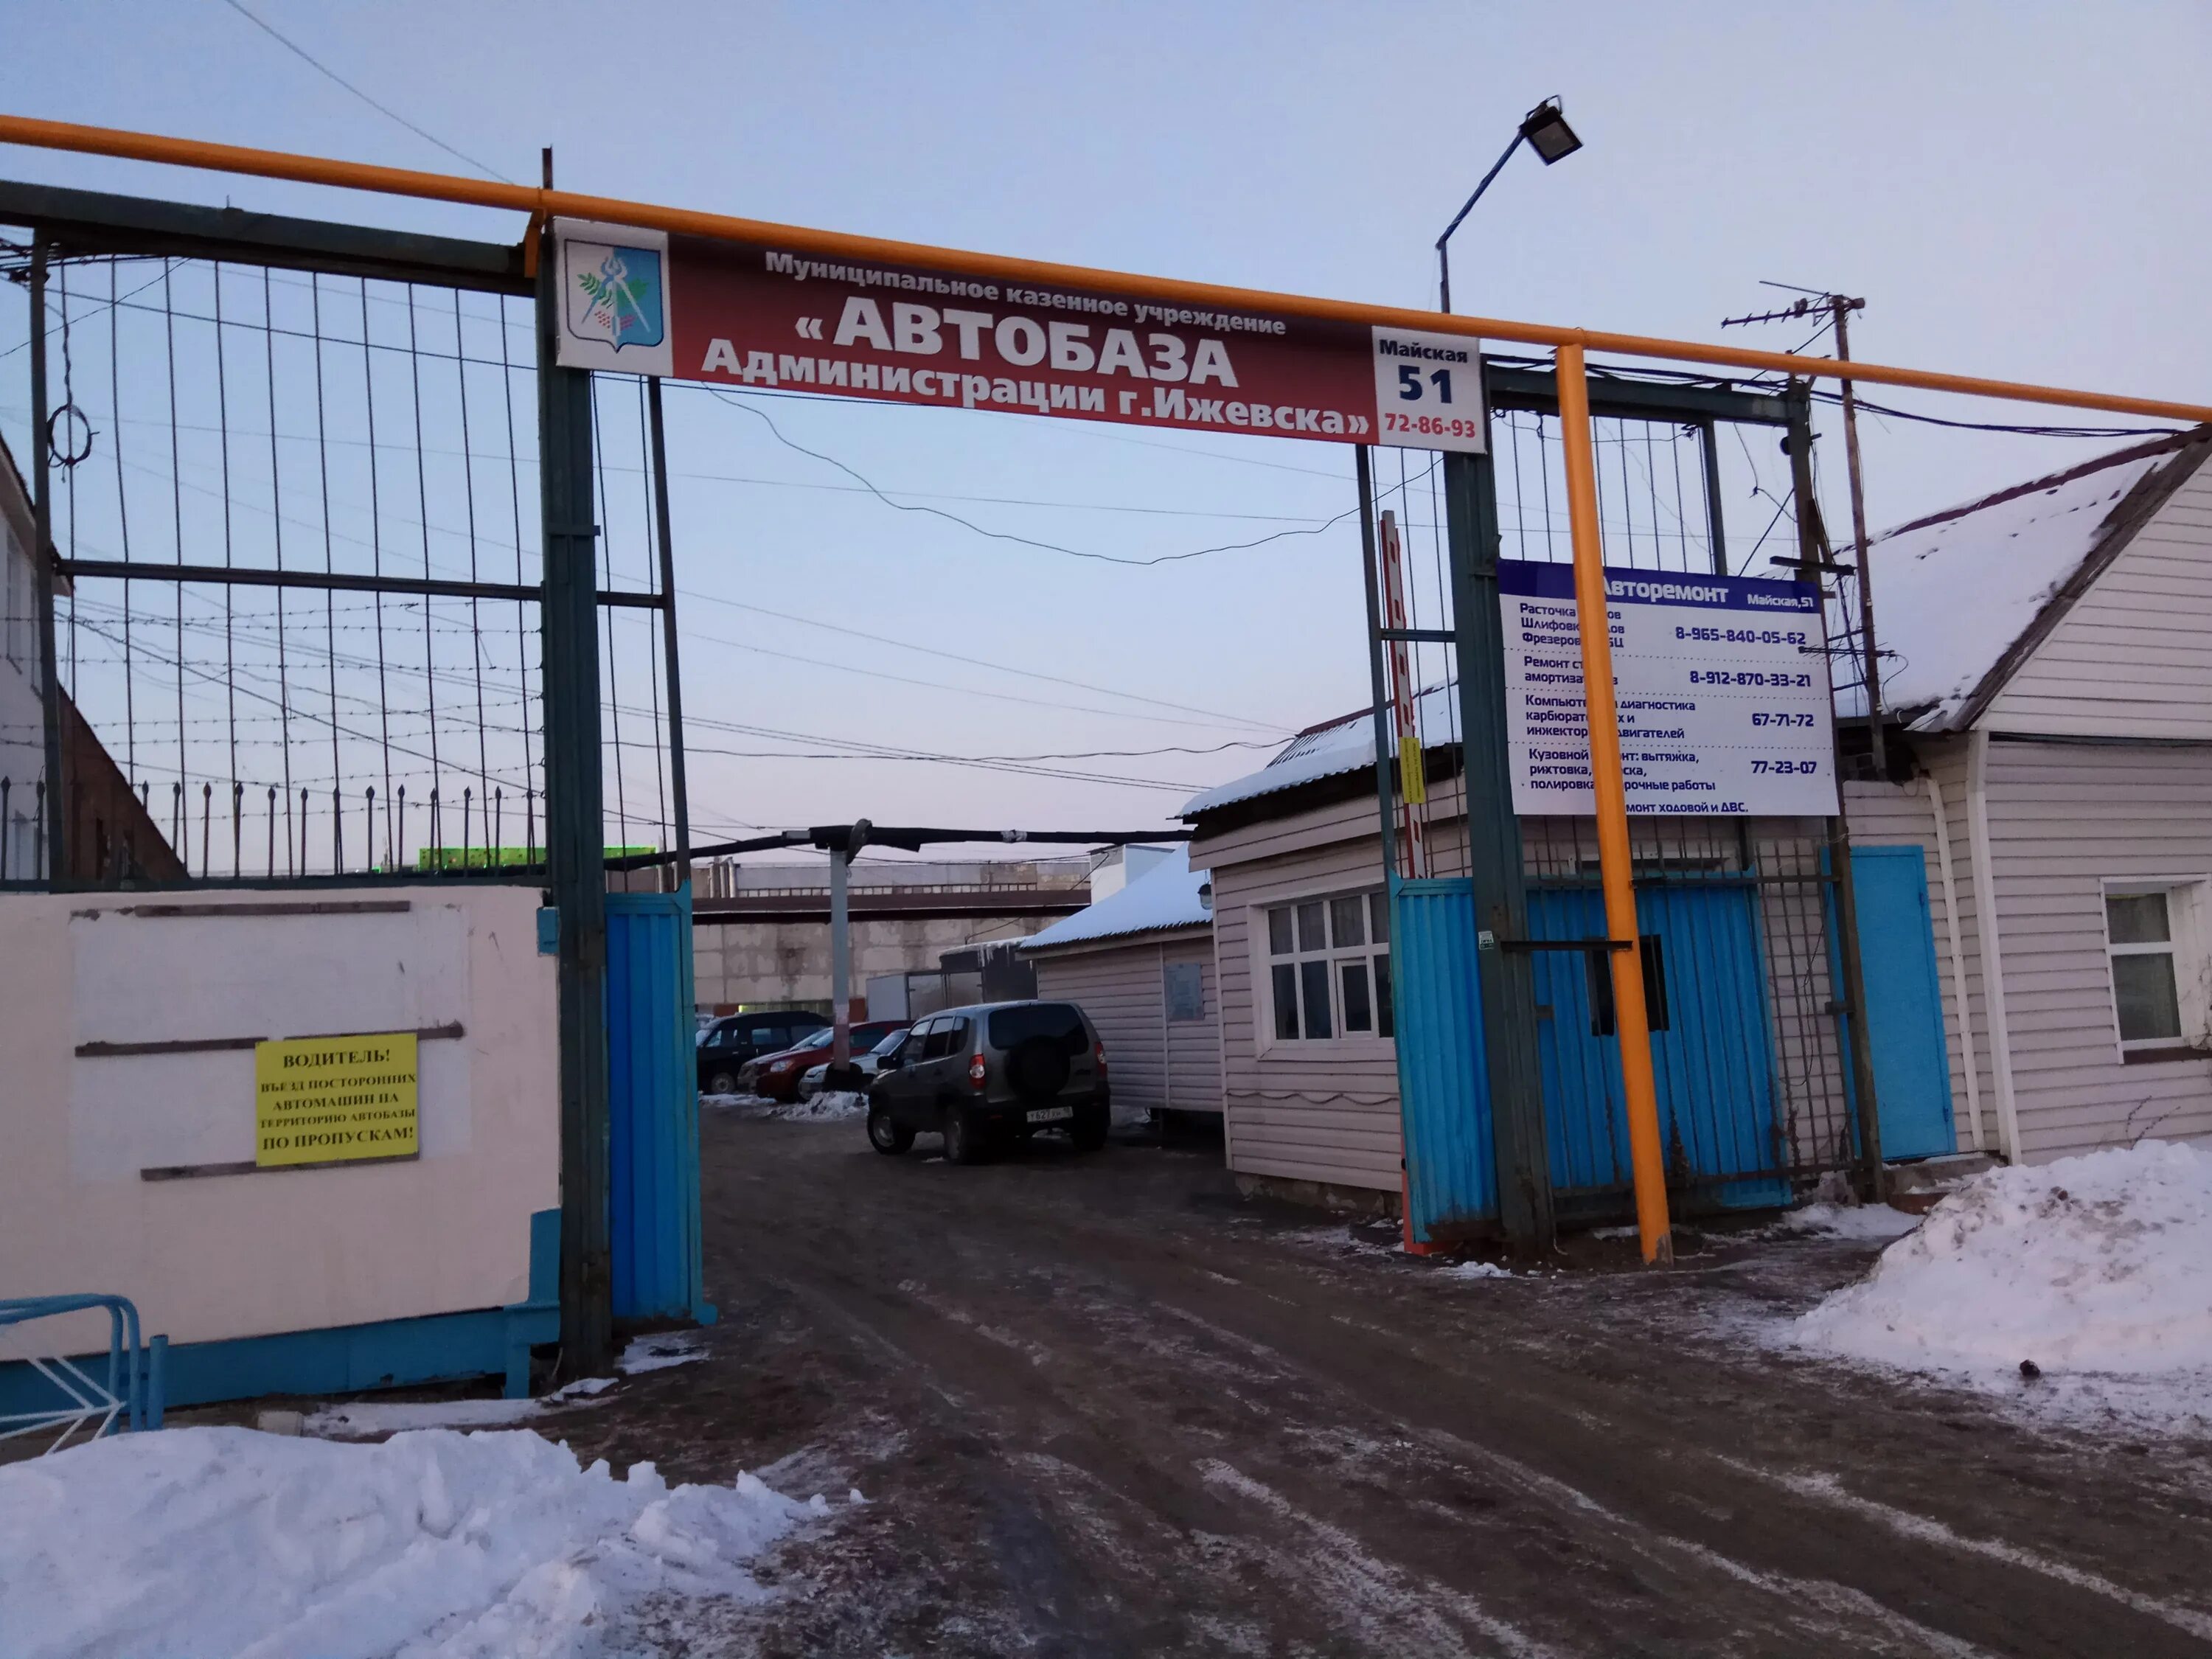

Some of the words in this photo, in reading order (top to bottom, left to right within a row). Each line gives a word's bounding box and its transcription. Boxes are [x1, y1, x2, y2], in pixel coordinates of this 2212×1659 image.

[765, 251, 999, 301] Муниципальное
[1006, 286, 1128, 317] казенное
[1134, 303, 1287, 335] учреждение
[1379, 338, 1468, 364] Майская
[701, 338, 1105, 414] Администрации
[1398, 364, 1453, 404] 51
[1385, 412, 1475, 438] 72-86-93
[1520, 602, 1576, 617] Расточка
[1521, 617, 1580, 632] Шлифовк
[1523, 632, 1581, 646] Фрезеров
[1675, 627, 1806, 644] 8-965-840-05-62
[1524, 655, 1570, 669] Ремонт
[1690, 670, 1811, 687] 8-912-870-33-21
[1620, 700, 1696, 711] диагностика
[1627, 714, 1635, 723] и
[1752, 713, 1815, 727] 67-71-72
[1529, 748, 1589, 760] Кузовной
[1641, 752, 1700, 763] вытяжка,
[1750, 760, 1818, 774] 77-23-07
[1672, 780, 1716, 791] работы
[1658, 801, 1708, 813] ходовой
[1711, 804, 1719, 813] и
[283, 1049, 390, 1068] ВОДИТЕЛЬ!
[308, 1073, 417, 1090] ПОСТОРОННИХ
[273, 1094, 375, 1111] АВТОМАШИН
[379, 1093, 399, 1104] НА
[260, 1115, 347, 1129] ТЕРРИТОРИЮ
[350, 1108, 416, 1122] АВТОБАЗЫ
[262, 1137, 289, 1150] ПО
[294, 1127, 414, 1148] ПРОПУСКАМ!
